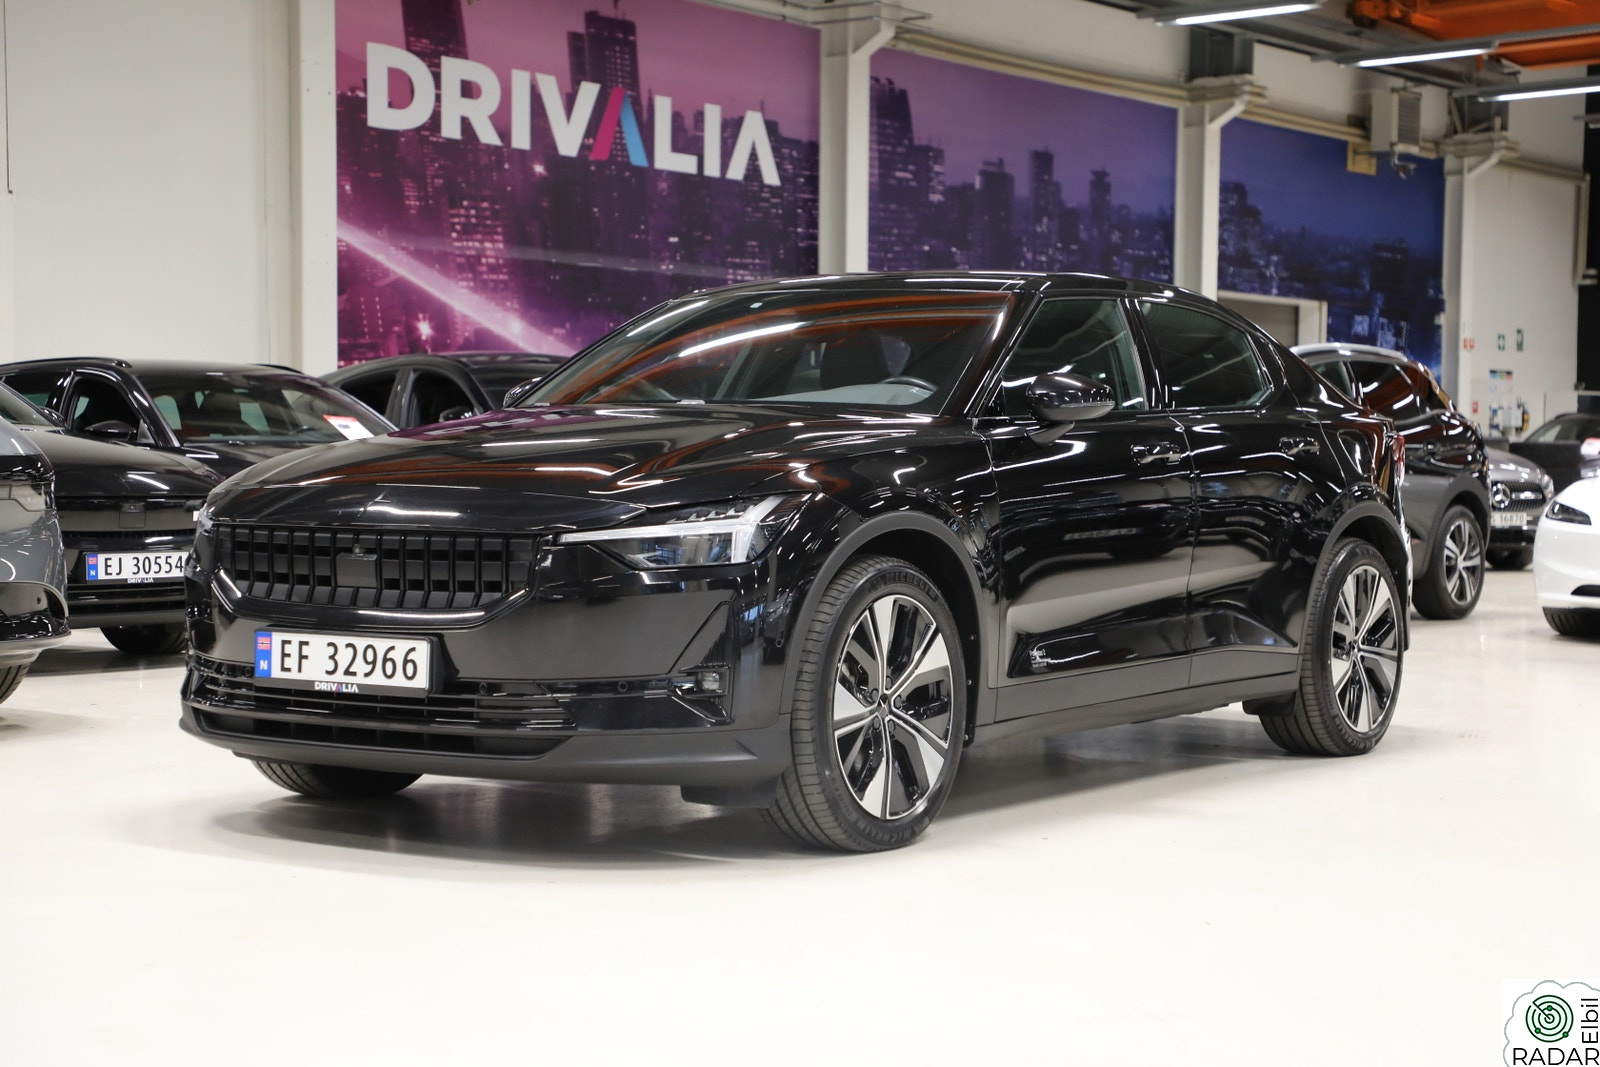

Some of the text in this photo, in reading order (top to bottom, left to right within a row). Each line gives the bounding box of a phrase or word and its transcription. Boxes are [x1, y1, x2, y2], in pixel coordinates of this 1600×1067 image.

[366, 42, 781, 186] DRIVALIA
[104, 555, 184, 576] EJ 30554
[259, 659, 268, 671] N
[280, 639, 418, 681] EF 32966
[314, 681, 359, 693] DRIVALIA
